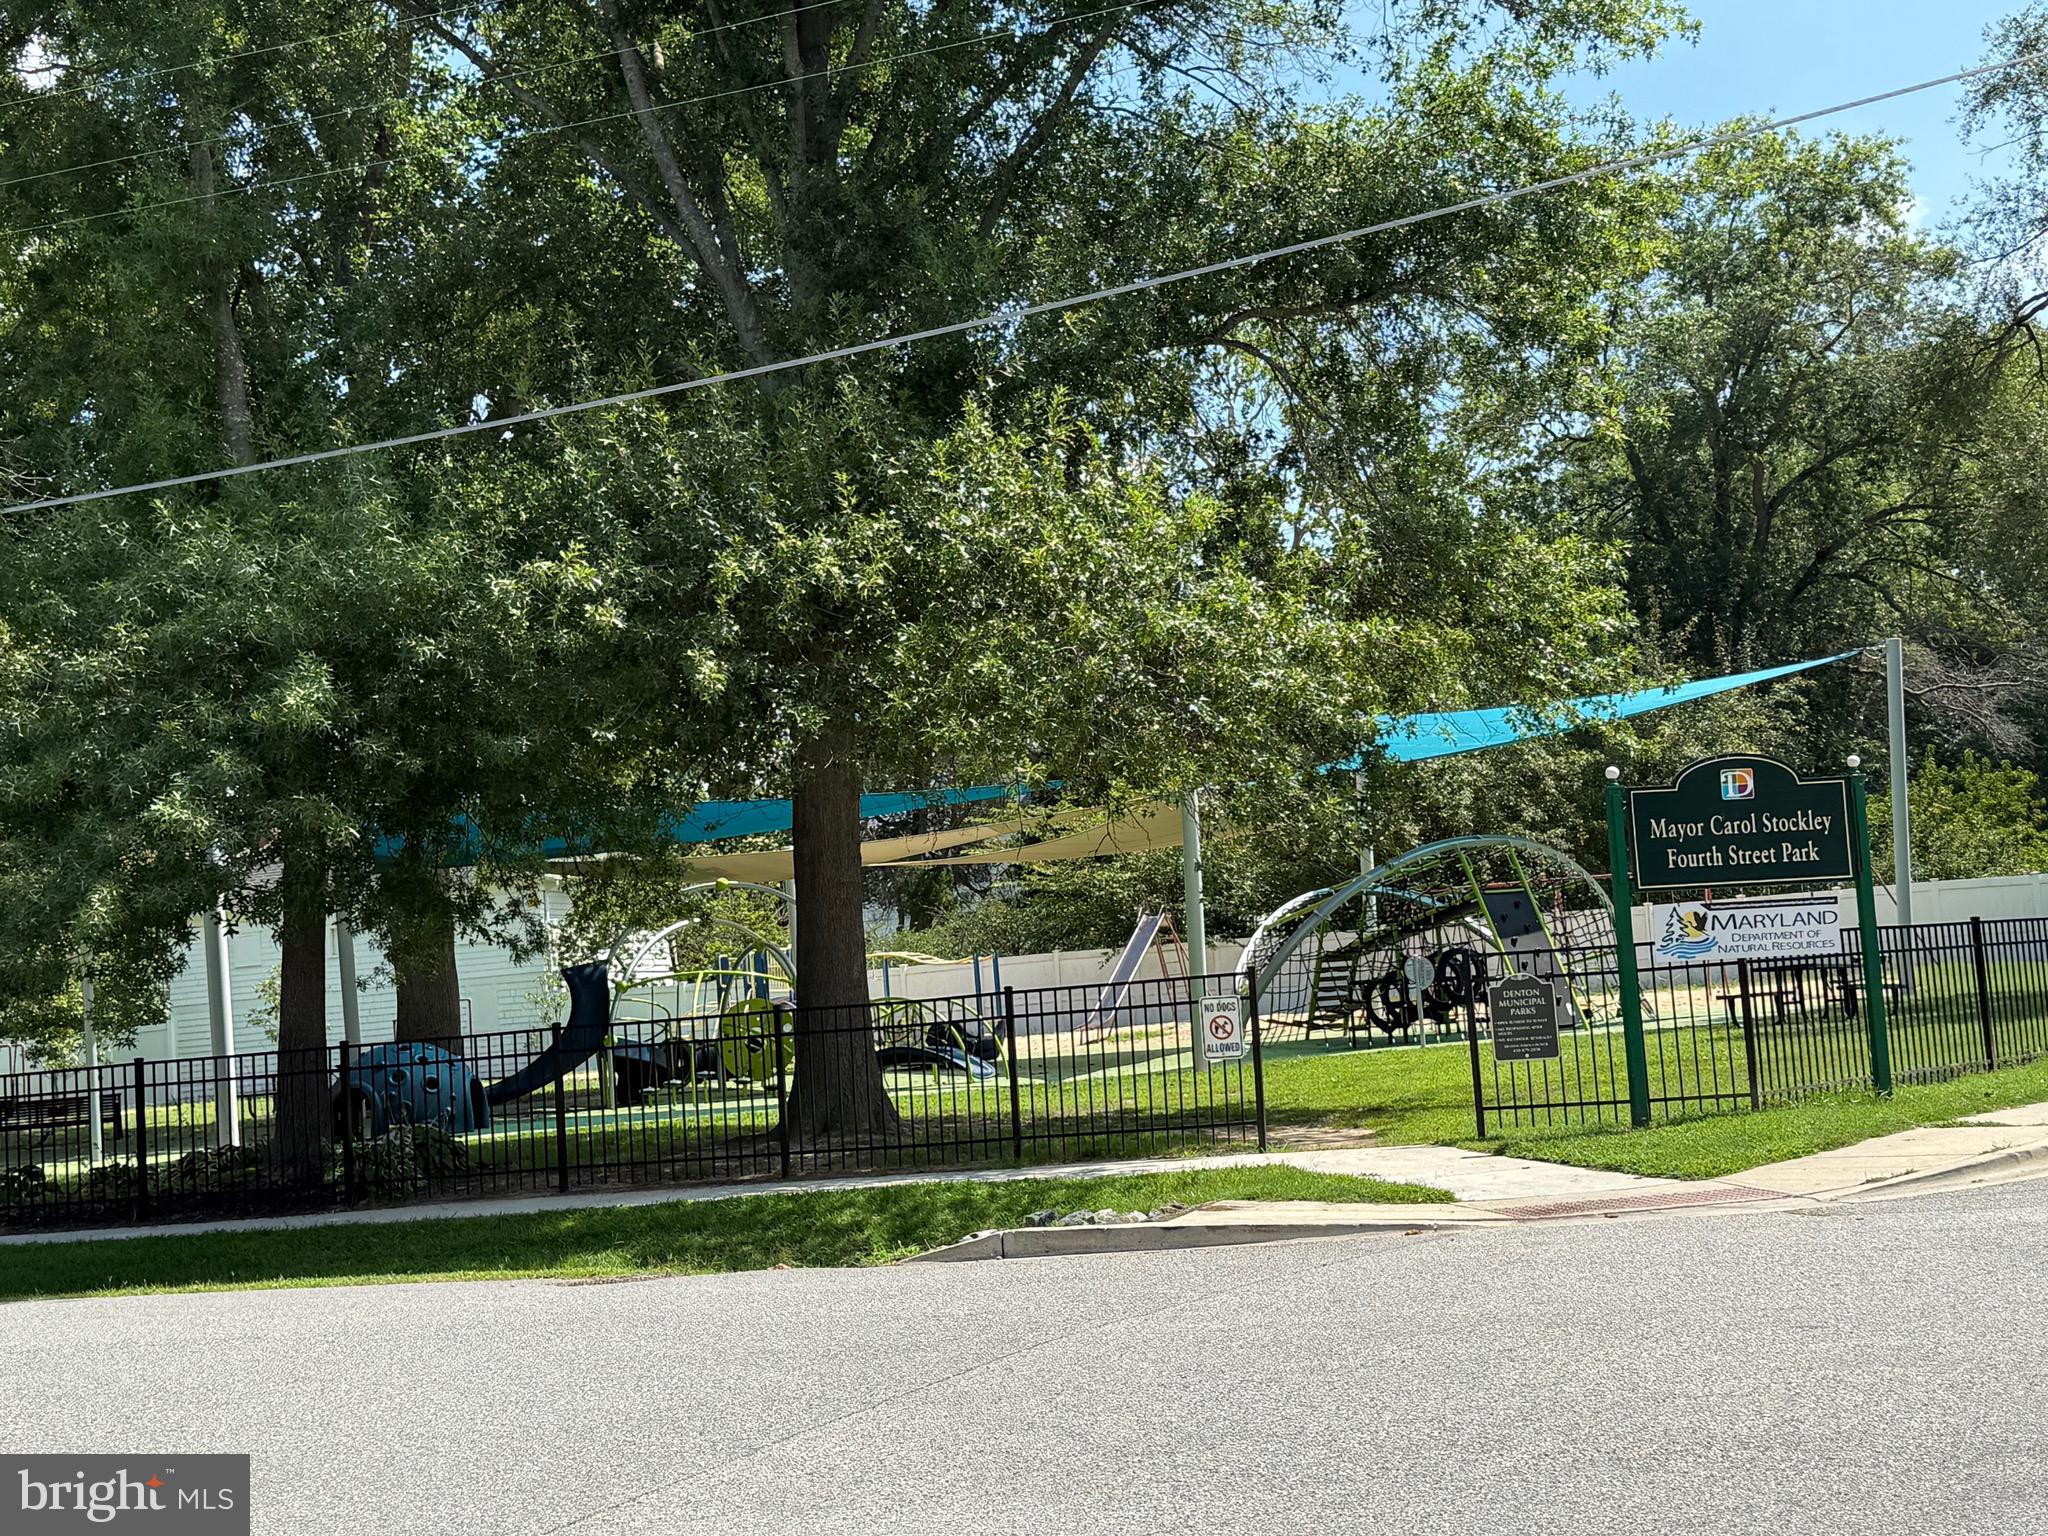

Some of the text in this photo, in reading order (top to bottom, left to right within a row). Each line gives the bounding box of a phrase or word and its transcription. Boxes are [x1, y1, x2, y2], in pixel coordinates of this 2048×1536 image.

[1650, 809, 1832, 843] Mayor Carol Stockley
[1667, 841, 1820, 868] Fourth Street Park
[1711, 910, 1838, 931] MARYLAND
[1731, 930, 1822, 942] DEPARTMENT OF
[1717, 939, 1835, 954] NATURAL RESOURCES
[1503, 989, 1540, 998] DENTON
[1204, 1002, 1236, 1013] NO DOGS
[1499, 997, 1547, 1008] MUNICIPAL
[1510, 1007, 1536, 1016] PARKS
[1207, 1042, 1240, 1053] ALLOWED
